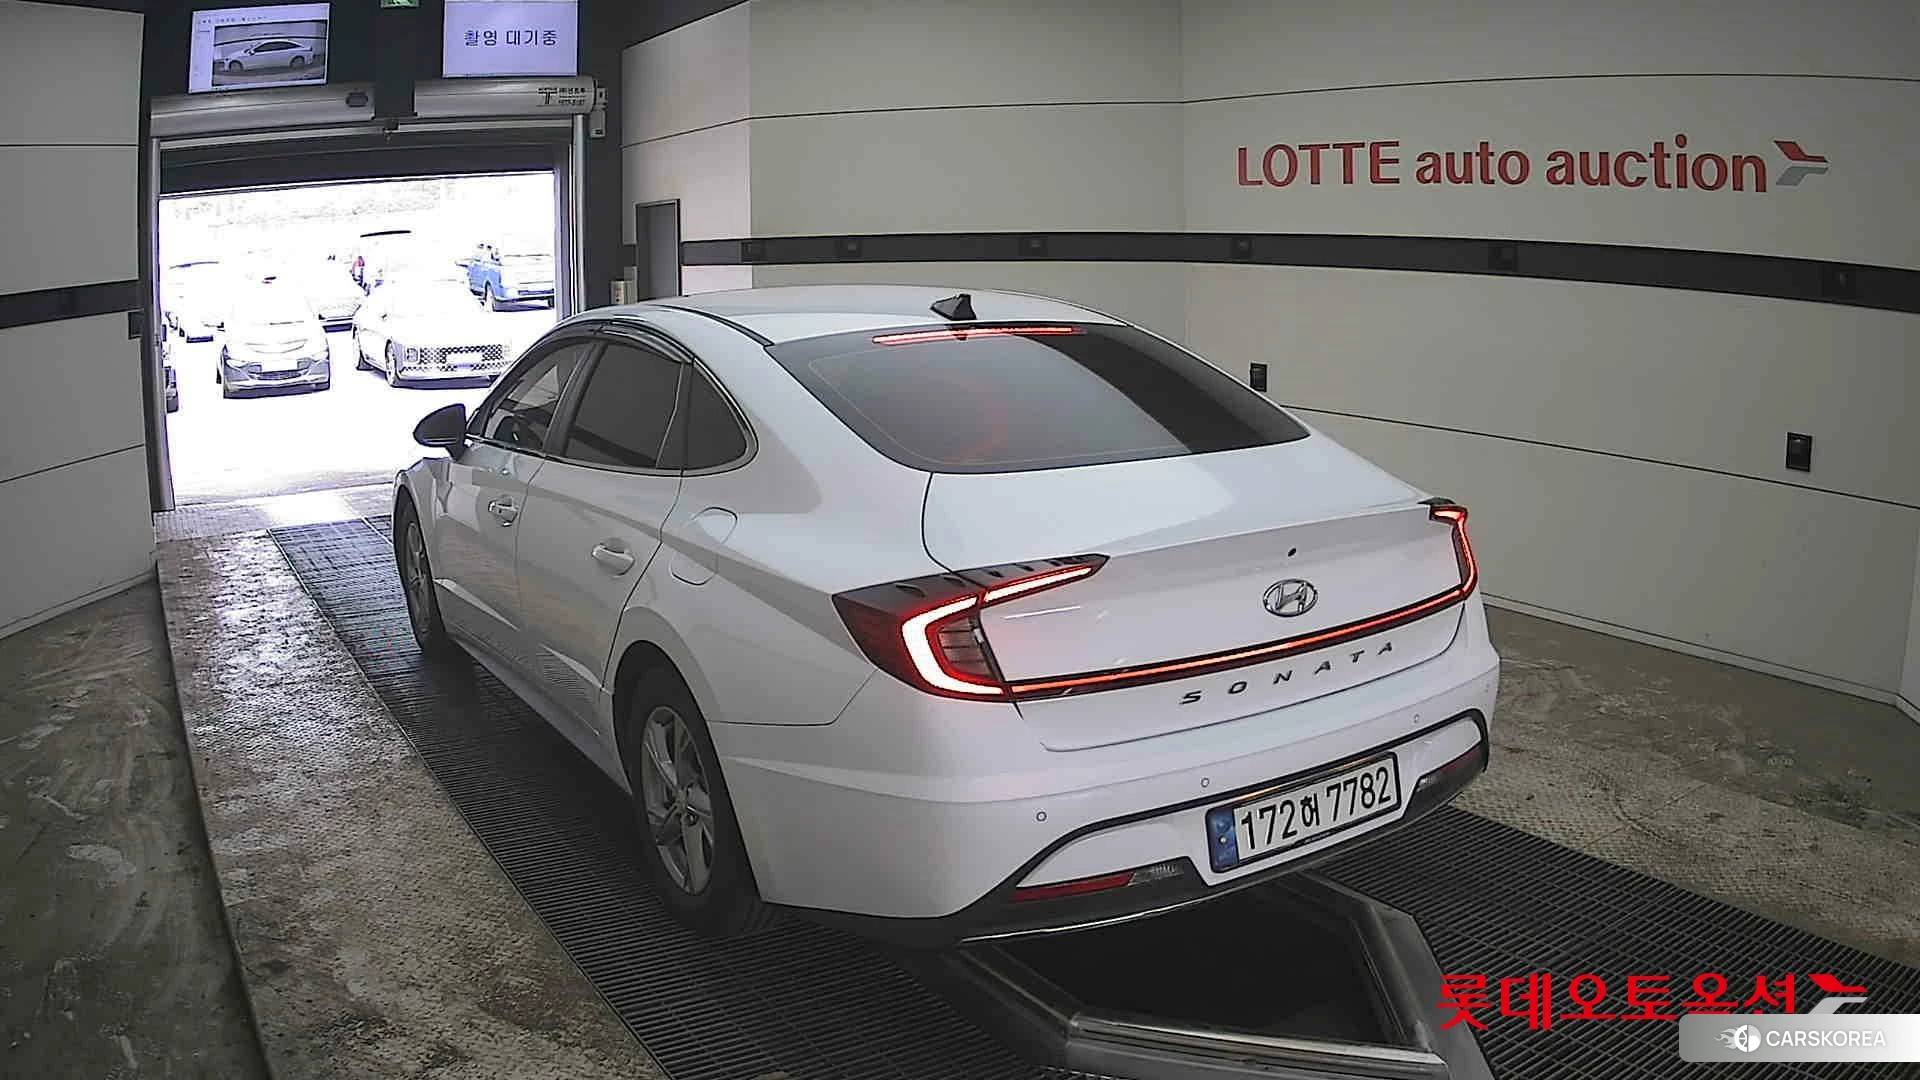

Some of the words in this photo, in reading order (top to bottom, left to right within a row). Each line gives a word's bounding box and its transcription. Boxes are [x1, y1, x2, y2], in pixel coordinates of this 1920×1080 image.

[465, 30, 497, 46] 촬영
[505, 30, 557, 46] 대기중
[1237, 141, 1399, 188] LOTTE
[1415, 140, 1531, 186] auto
[1546, 133, 1767, 193] auction
[1180, 641, 1393, 704] SONATA
[1241, 793, 1320, 849] 172허
[1326, 766, 1391, 823] 7782
